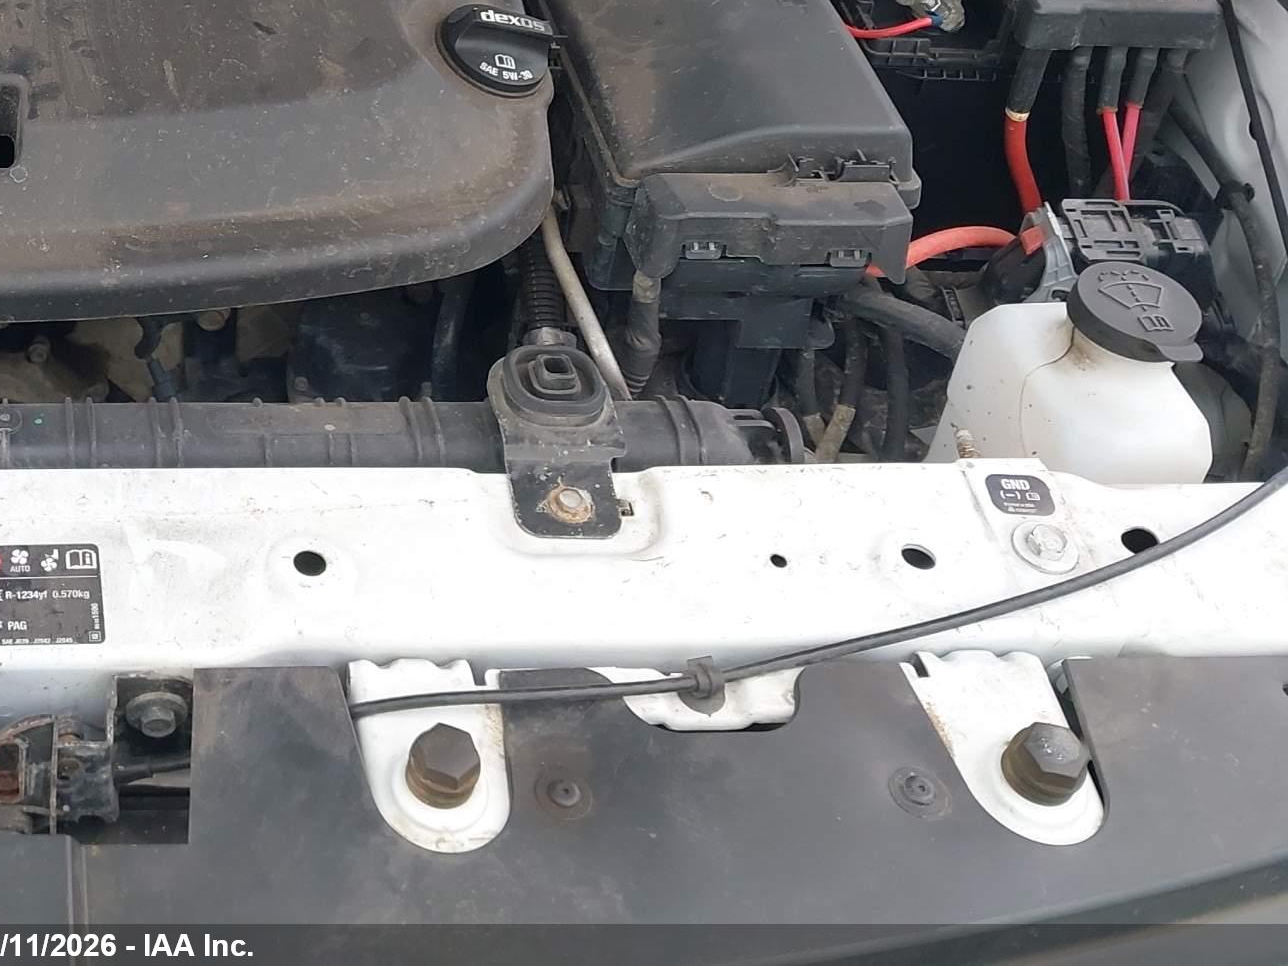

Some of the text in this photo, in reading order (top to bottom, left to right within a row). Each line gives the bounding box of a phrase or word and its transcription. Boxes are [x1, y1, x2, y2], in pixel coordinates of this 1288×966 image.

[479, 9, 546, 32] dexos
[479, 61, 499, 77] SAE
[1000, 478, 1031, 491] GND
[9, 564, 31, 573] AUTO
[5, 589, 90, 601] R-1234yf 0.570kg
[7, 620, 28, 631] PAG
